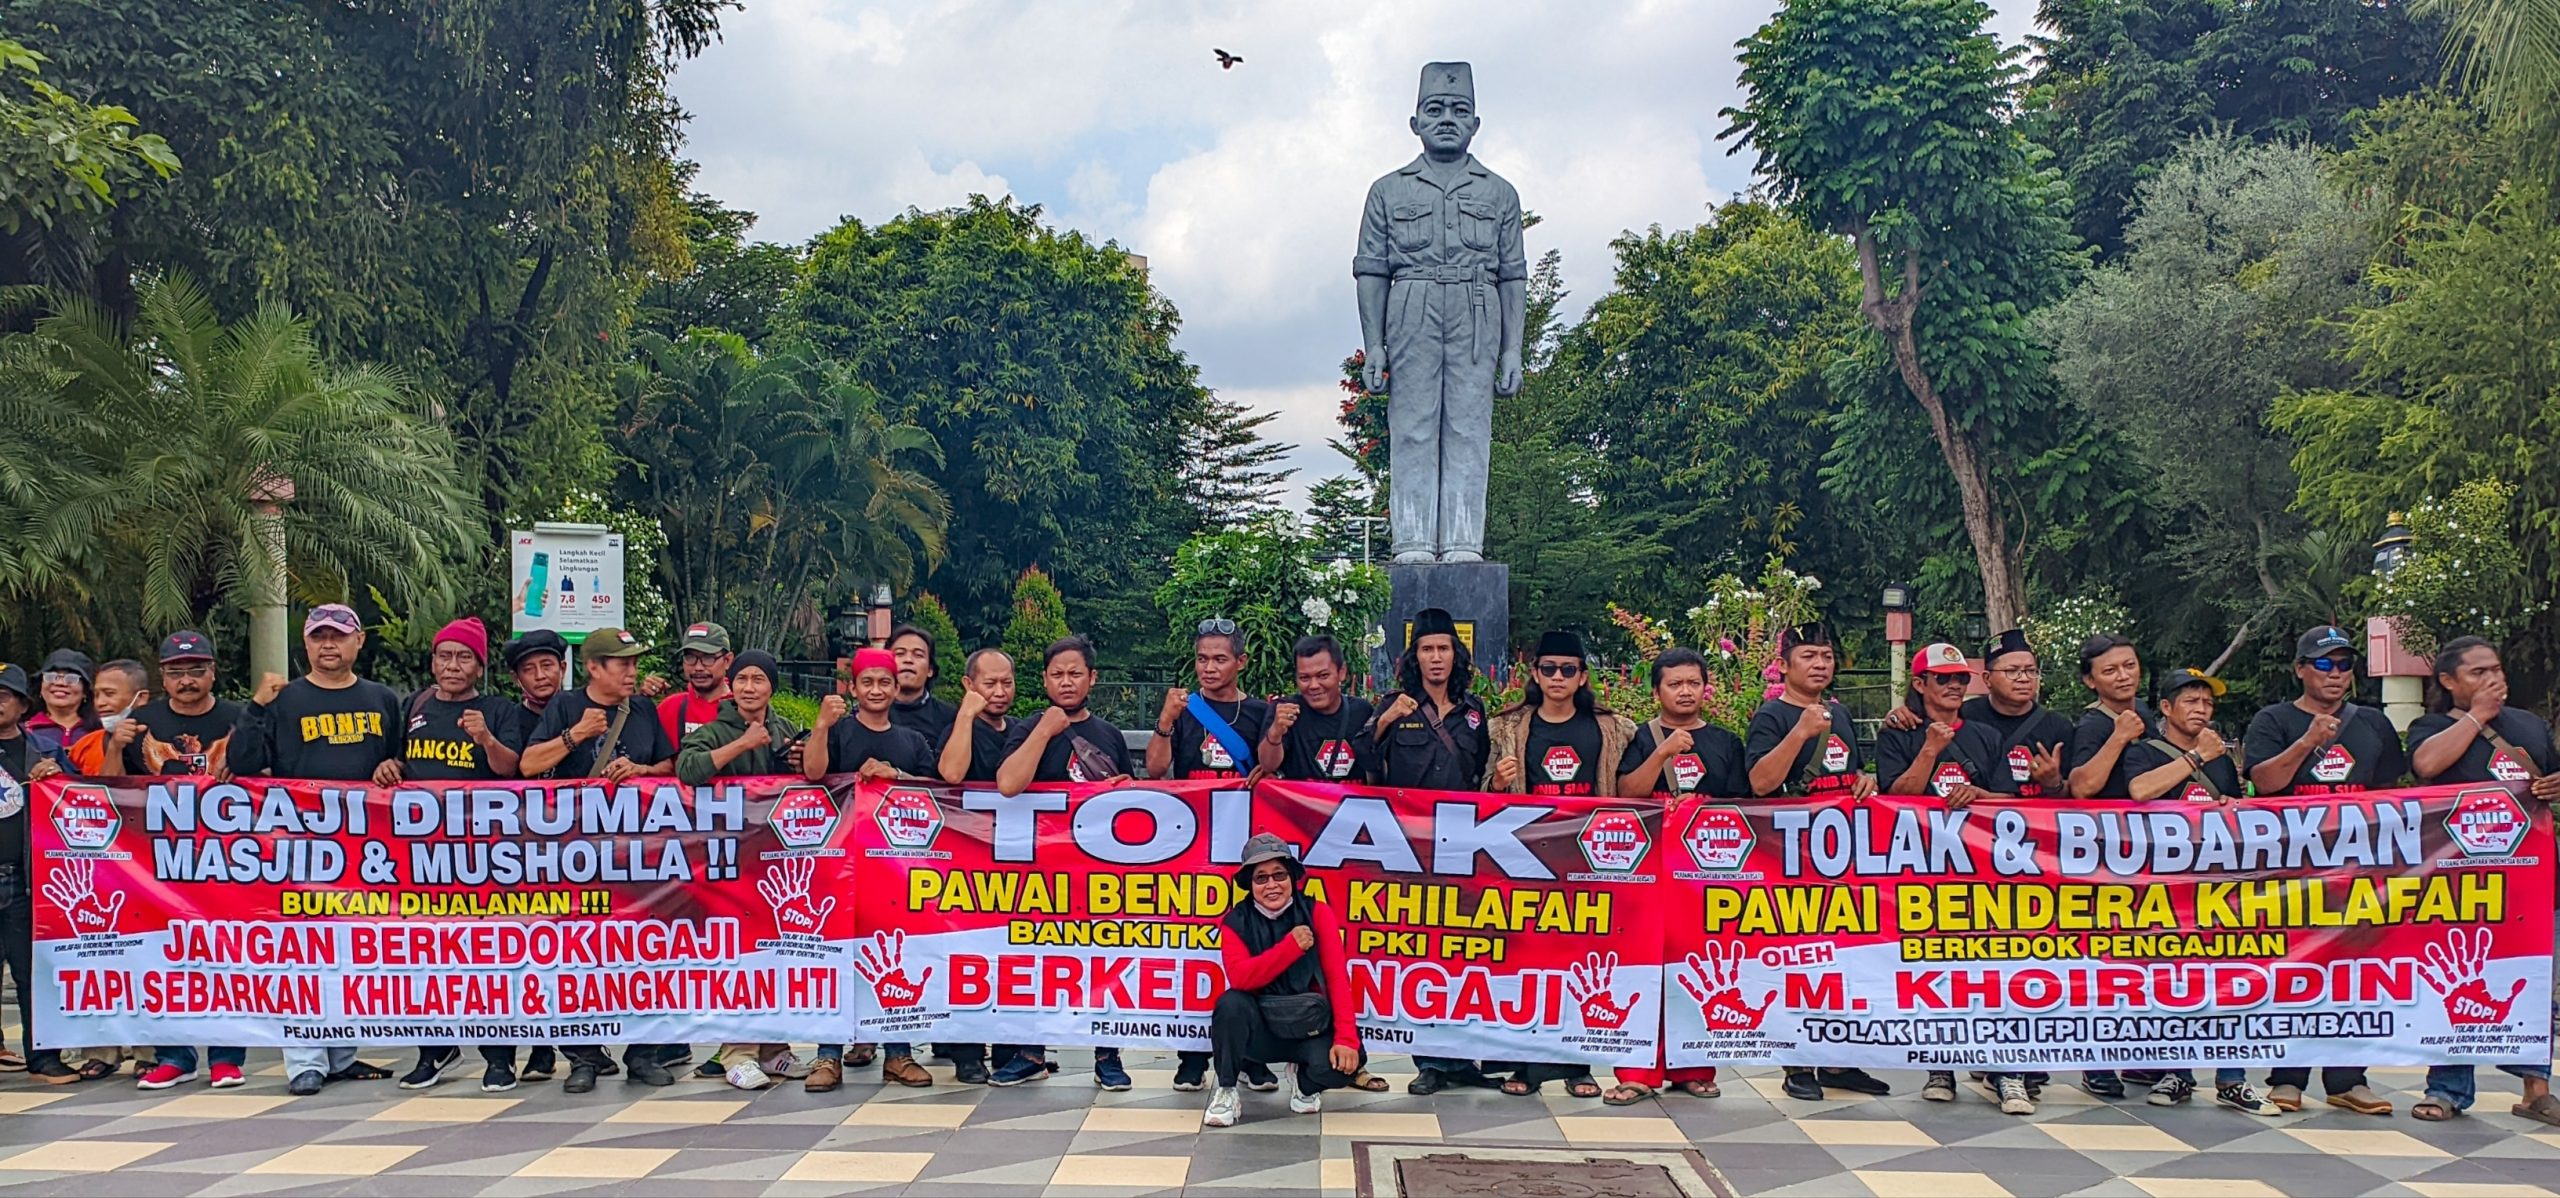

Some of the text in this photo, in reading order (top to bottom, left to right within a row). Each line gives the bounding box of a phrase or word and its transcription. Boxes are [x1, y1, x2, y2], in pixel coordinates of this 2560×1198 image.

[559, 549, 588, 557] Langkah
[559, 565, 599, 573] Lingkungan
[560, 594, 576, 604] 7,8
[591, 595, 611, 604] 450
[301, 711, 383, 742] BONEK
[406, 738, 474, 761] JANCOK
[146, 783, 744, 836] NGAJI DIRUMAH
[782, 807, 826, 828] PNIB
[888, 807, 930, 828] PNIB
[2460, 811, 2513, 834] PNIB
[962, 789, 1557, 880] TOLAK
[1591, 830, 1636, 851] PNIB
[1696, 828, 1741, 849] PNIB
[1774, 800, 2422, 877] TOLAK & BUBARKAN
[154, 837, 738, 883] MASJID & MUSHOLLA !!
[282, 890, 611, 917] BUKAN DIJALANAN !!!
[909, 869, 1069, 914] PAWAI
[1348, 881, 1613, 934] KHILAFAH
[1705, 873, 2503, 934] PAWAI BENDERA KHILAFAH
[77, 909, 106, 927] STOP!
[782, 907, 813, 929] STOP!
[163, 920, 735, 965] JANGAN BERKEDOK NGAJI
[1359, 930, 1427, 957] PKI
[1441, 935, 1506, 962] FPI
[1902, 933, 2287, 962] BERKEDOK PENGAJIAN
[1760, 945, 1835, 967] OLEH
[59, 967, 836, 1016] TAPI SEBARKAN KHILAFAH & BANGKITKAN HTI
[882, 982, 914, 1001] STOP!
[948, 953, 1562, 1027] BERKED NGAJI
[1785, 961, 2413, 1010] M. KHOIRUDDIN
[1586, 1003, 1619, 1024] STOP!
[1711, 1003, 1752, 1027] STOP!
[2454, 996, 2497, 1020] STOP!
[284, 1022, 621, 1040] PEJUANG NUSANTARA INDONESIA BERSATU
[1091, 1021, 1161, 1038] PEJUANG
[1712, 1031, 1733, 1039] TOLAK
[1804, 1011, 2394, 1045] TOLAK HTI PKI FPI BANGKIT KEMBALI
[2454, 1025, 2476, 1033] TOLAK
[2485, 1024, 2513, 1032] LAWAN
[1682, 1041, 1712, 1049] KHILAFAH
[1759, 1041, 1797, 1049] TERORISME
[2420, 1035, 2549, 1045] KHILAFAH RADIKALISME TERORISME
[2448, 1046, 2474, 1054] POLITIK
[1707, 1051, 1732, 1059] POLITIK
[1908, 1044, 2286, 1065] PEJUANG NUSANTARA INDONESIA BERSATU
